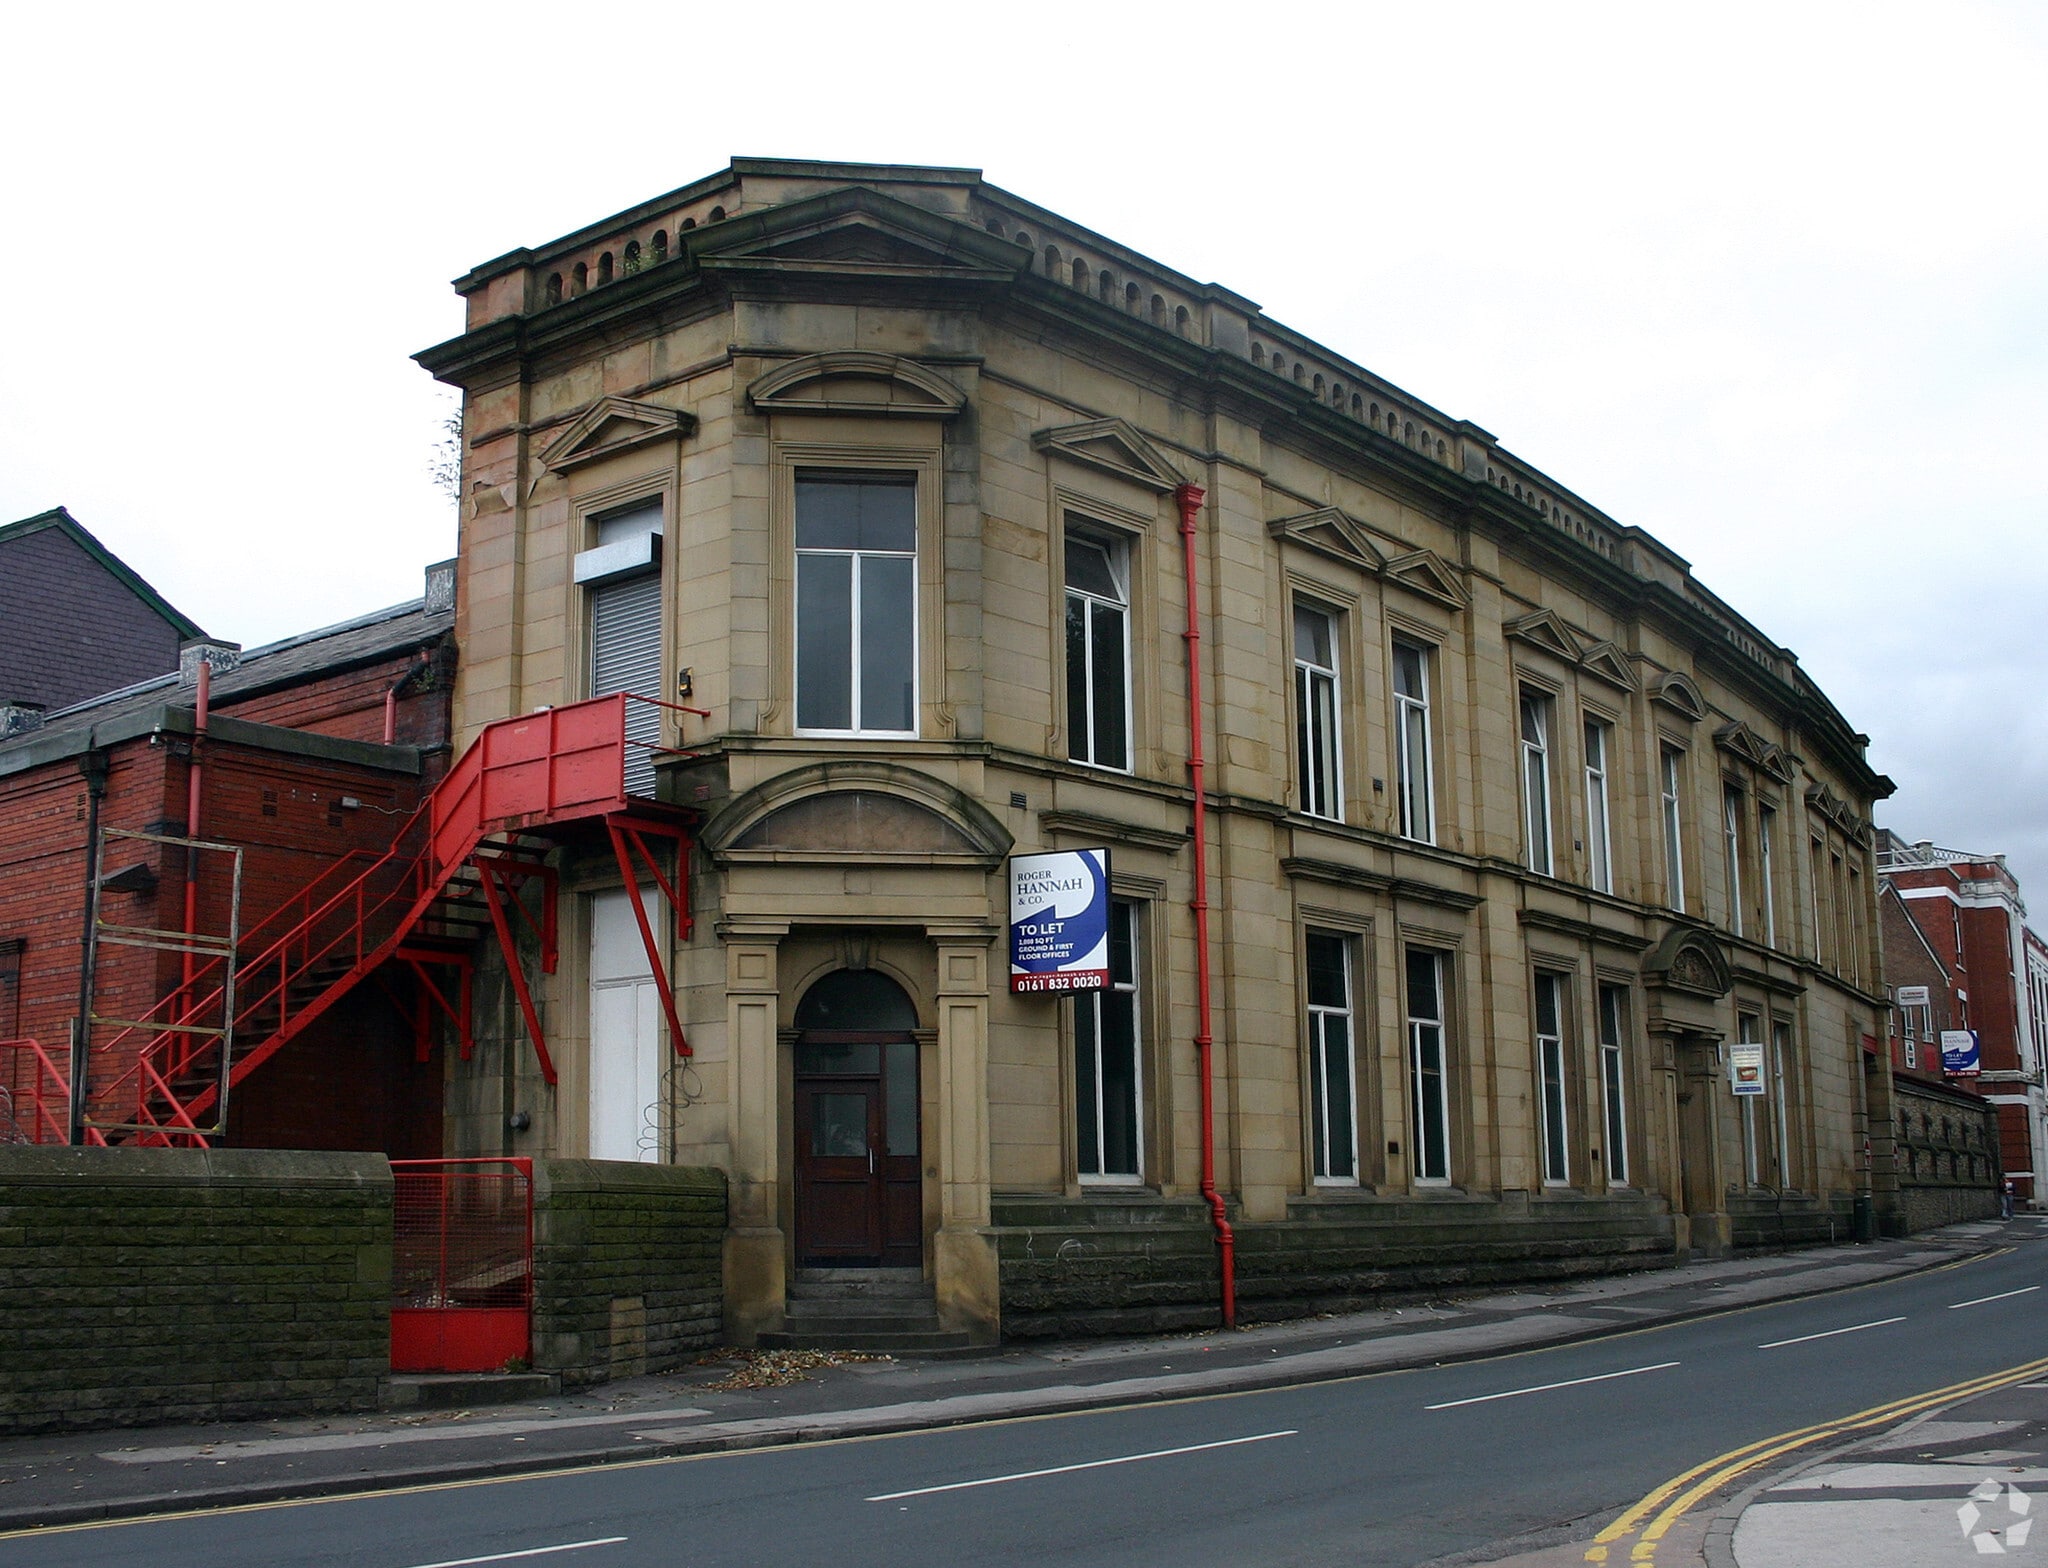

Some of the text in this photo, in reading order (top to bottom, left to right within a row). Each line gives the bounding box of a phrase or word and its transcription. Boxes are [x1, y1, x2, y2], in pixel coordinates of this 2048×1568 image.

[1017, 870, 1052, 882] ROGER
[1017, 878, 1083, 895] HANNAH
[1018, 896, 1044, 906] & CO.
[1018, 922, 1064, 936] TO LET
[1018, 976, 1101, 991] 0161 832 0020
